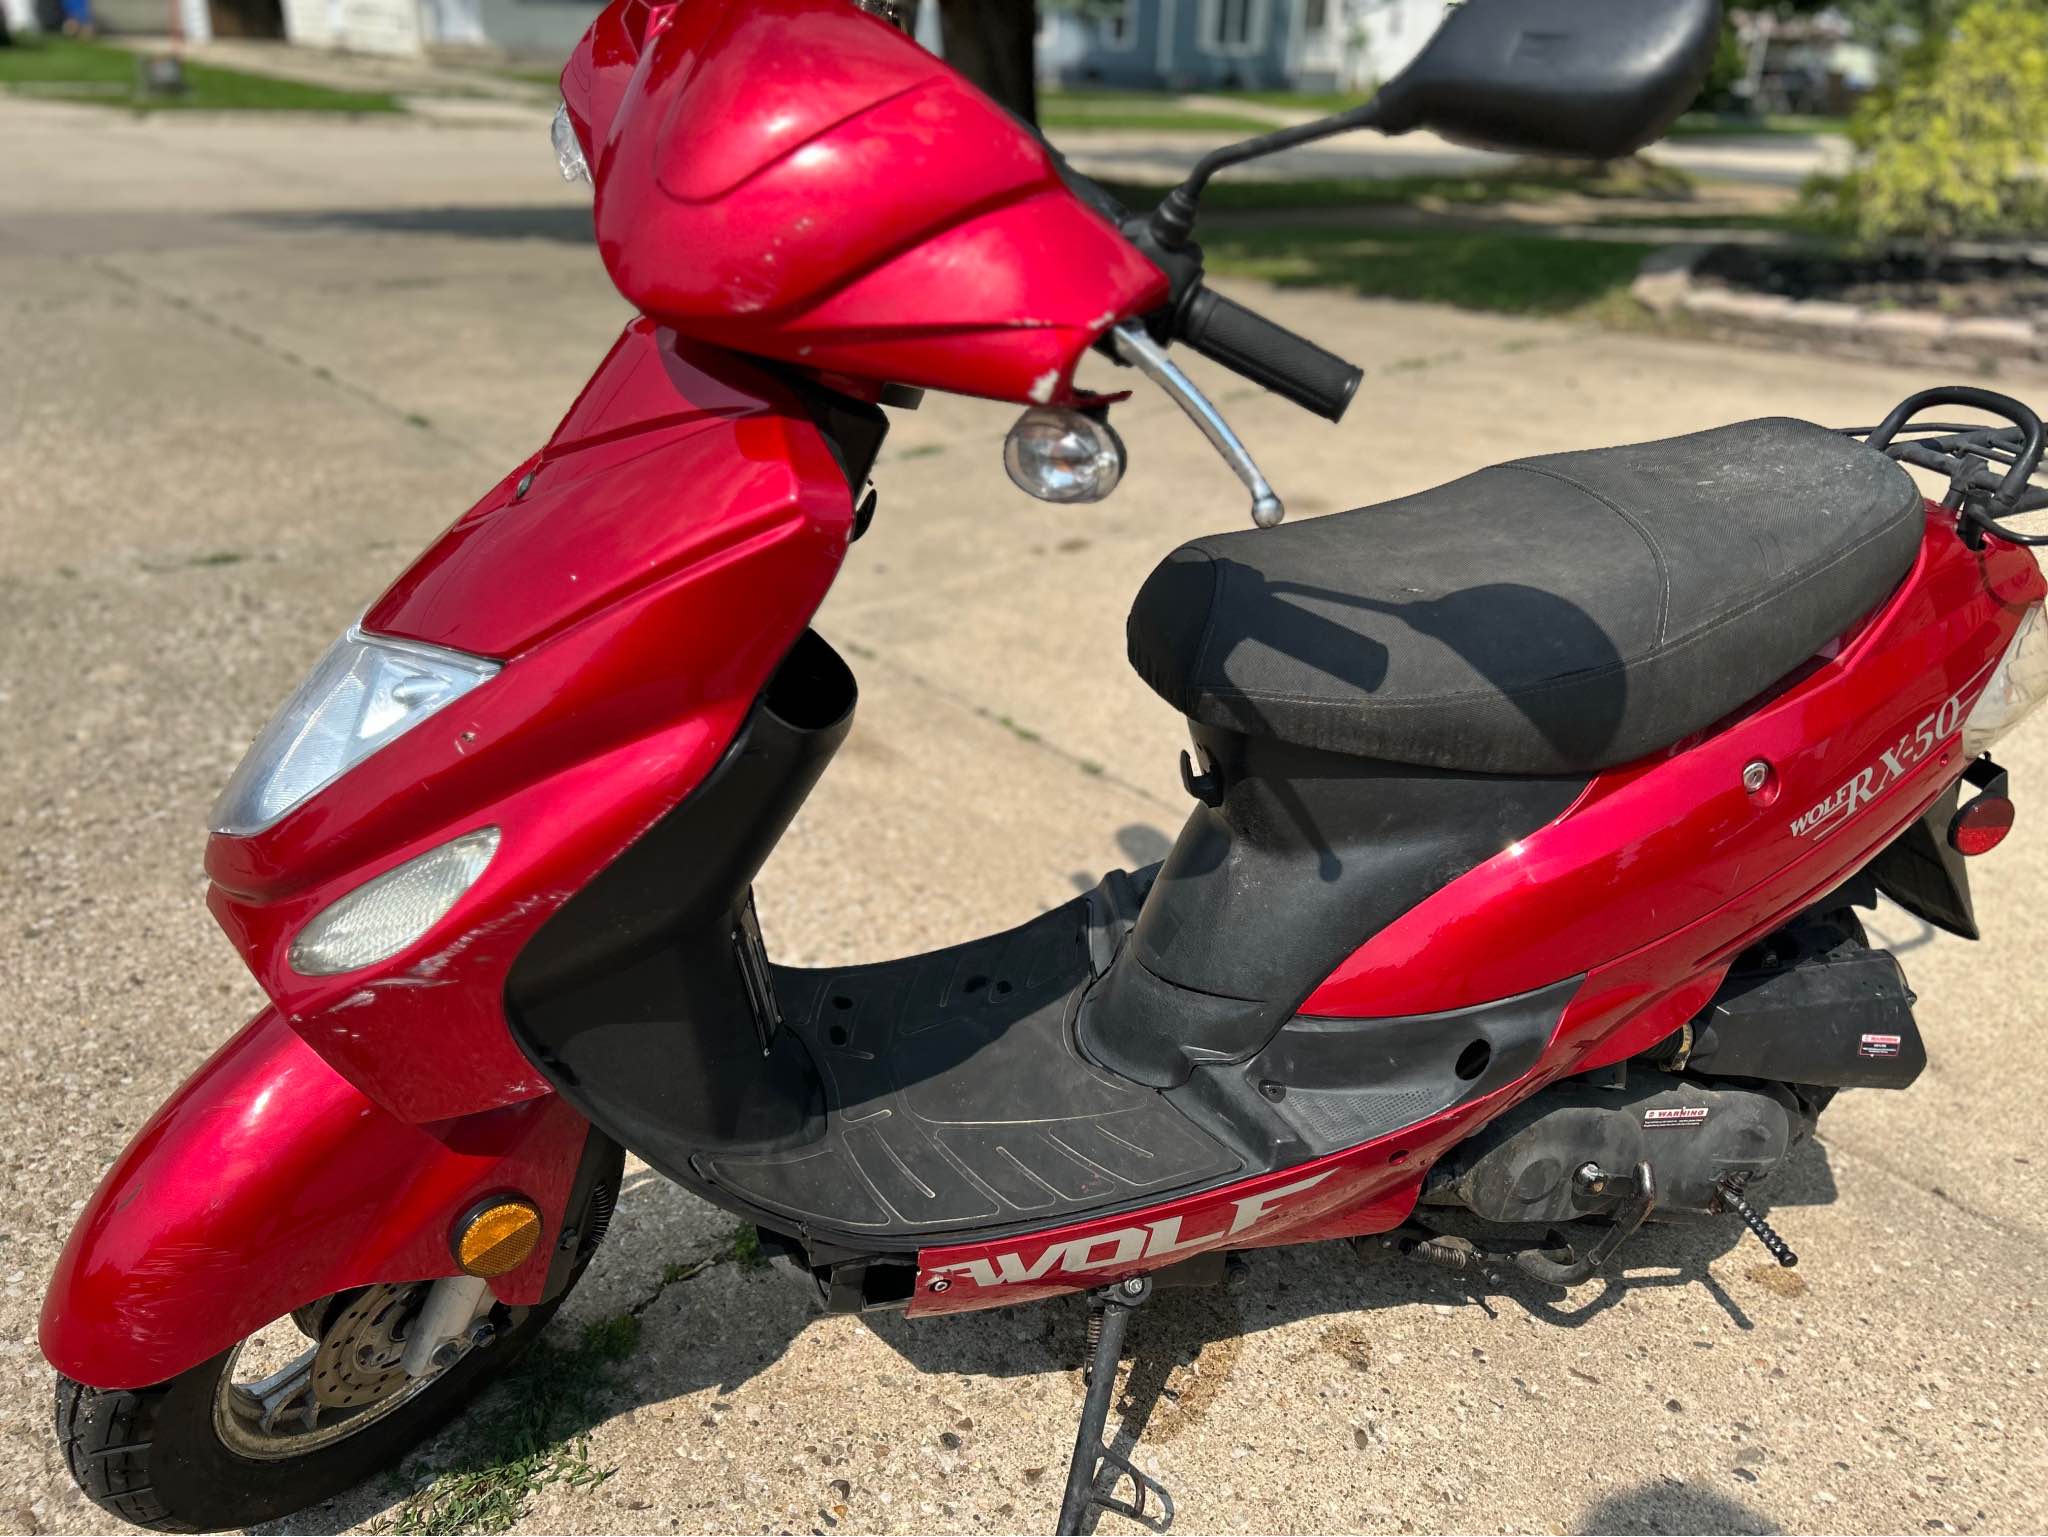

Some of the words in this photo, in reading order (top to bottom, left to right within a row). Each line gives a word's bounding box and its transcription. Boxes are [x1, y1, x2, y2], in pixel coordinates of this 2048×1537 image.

[1790, 783, 1850, 837] WOLF
[1658, 1109, 1705, 1117] WARNING
[927, 1167, 1341, 1288] WOLF
